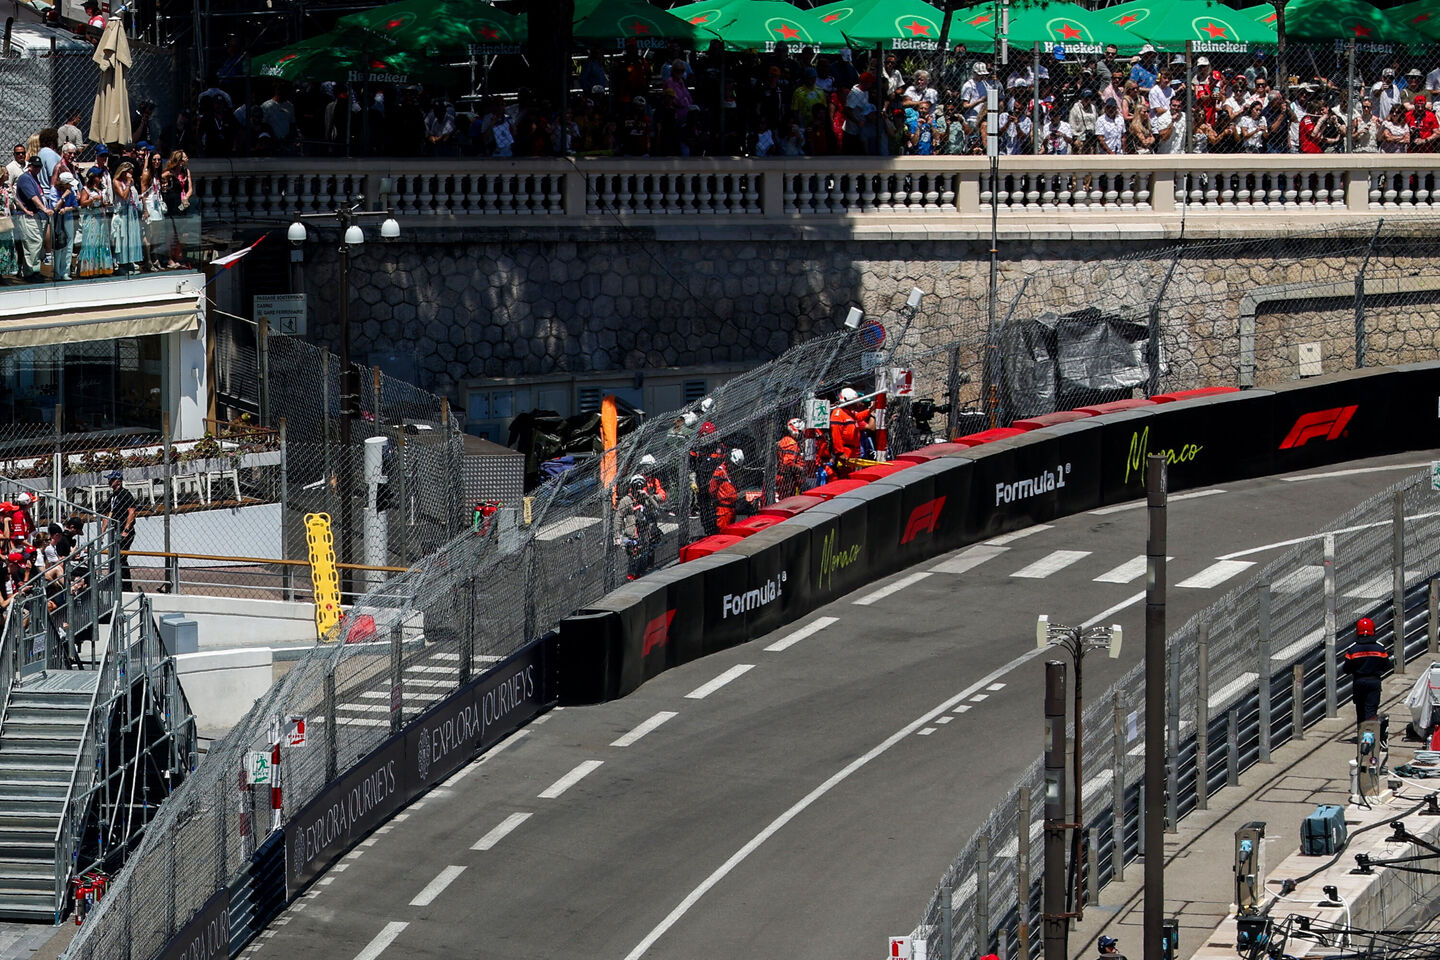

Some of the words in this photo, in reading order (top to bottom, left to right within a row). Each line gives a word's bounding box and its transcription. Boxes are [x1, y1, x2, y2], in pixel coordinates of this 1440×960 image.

[1192, 40, 1247, 53] Heineken
[1334, 39, 1393, 54] Heneken
[348, 70, 408, 83] Heneken
[1124, 426, 1204, 488] Maco
[995, 470, 1055, 507] Formula
[819, 528, 862, 592] Monaco
[722, 578, 776, 619] Formula
[432, 701, 480, 763] EXPLORA
[481, 664, 534, 738] JOURNEYS
[306, 803, 348, 862] EXPLORA
[347, 760, 396, 836] JOURNEYS
